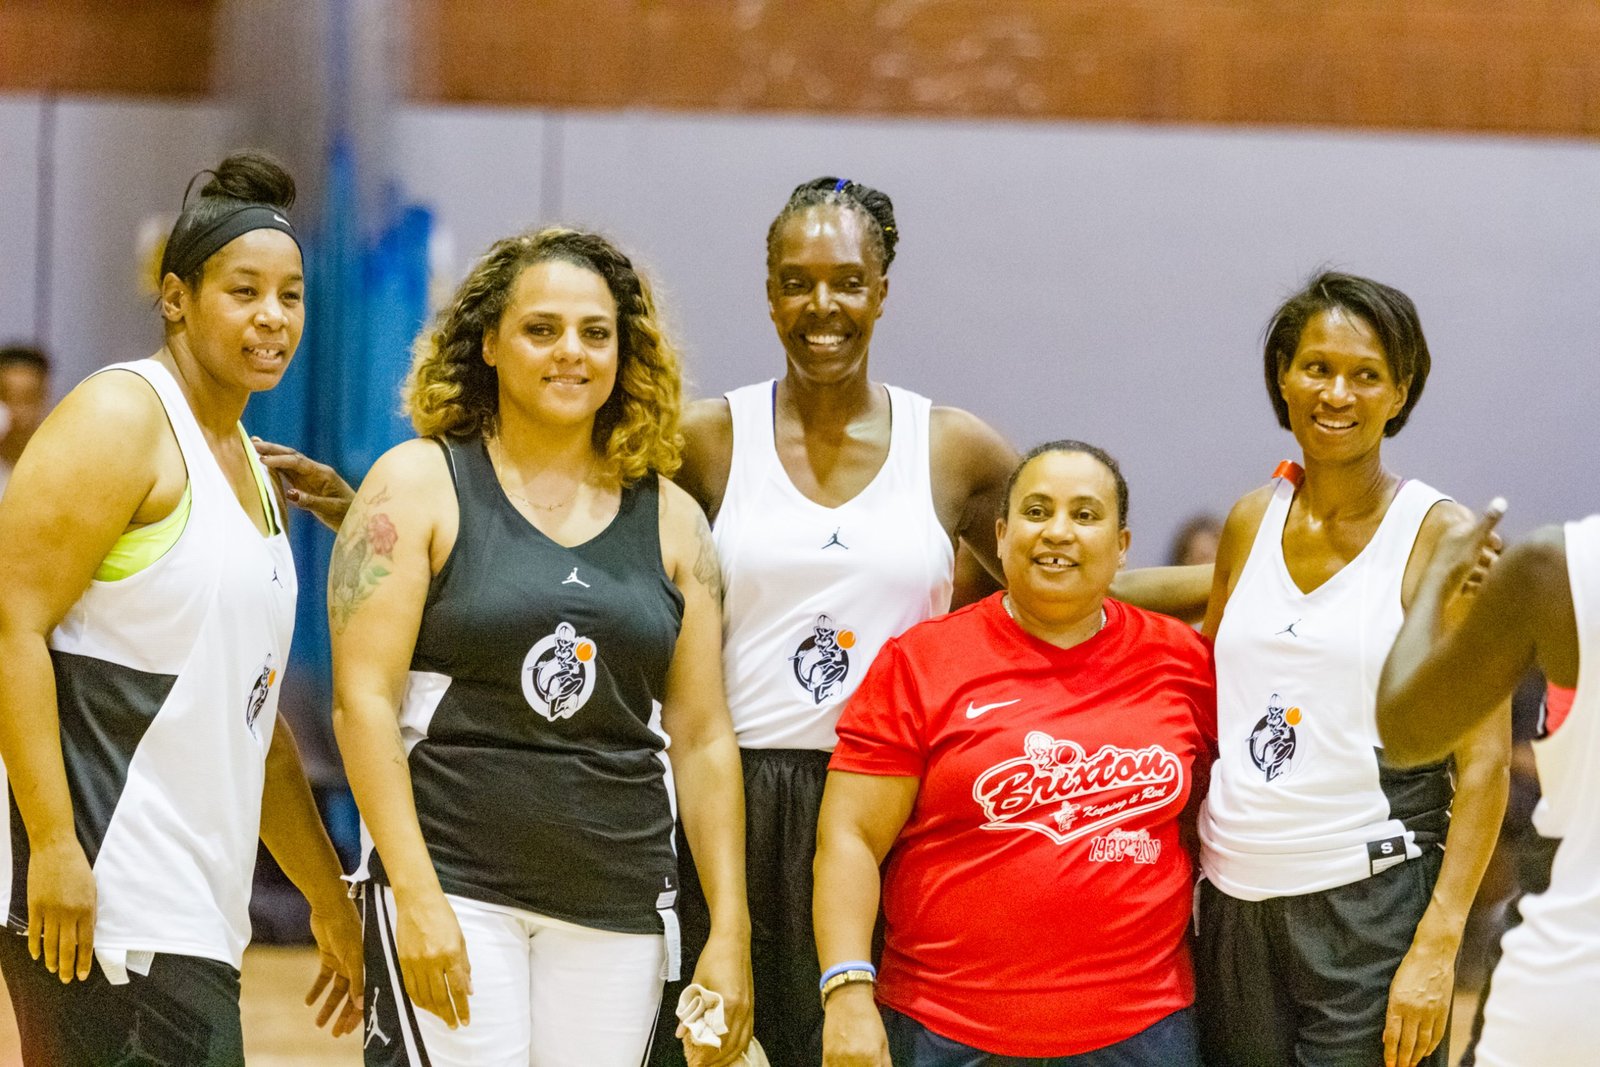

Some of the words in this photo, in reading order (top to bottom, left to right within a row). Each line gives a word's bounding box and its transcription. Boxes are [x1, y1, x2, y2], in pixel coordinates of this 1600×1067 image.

[977, 750, 1176, 820] Brixton
[1380, 841, 1394, 855] S
[664, 876, 672, 889] L
